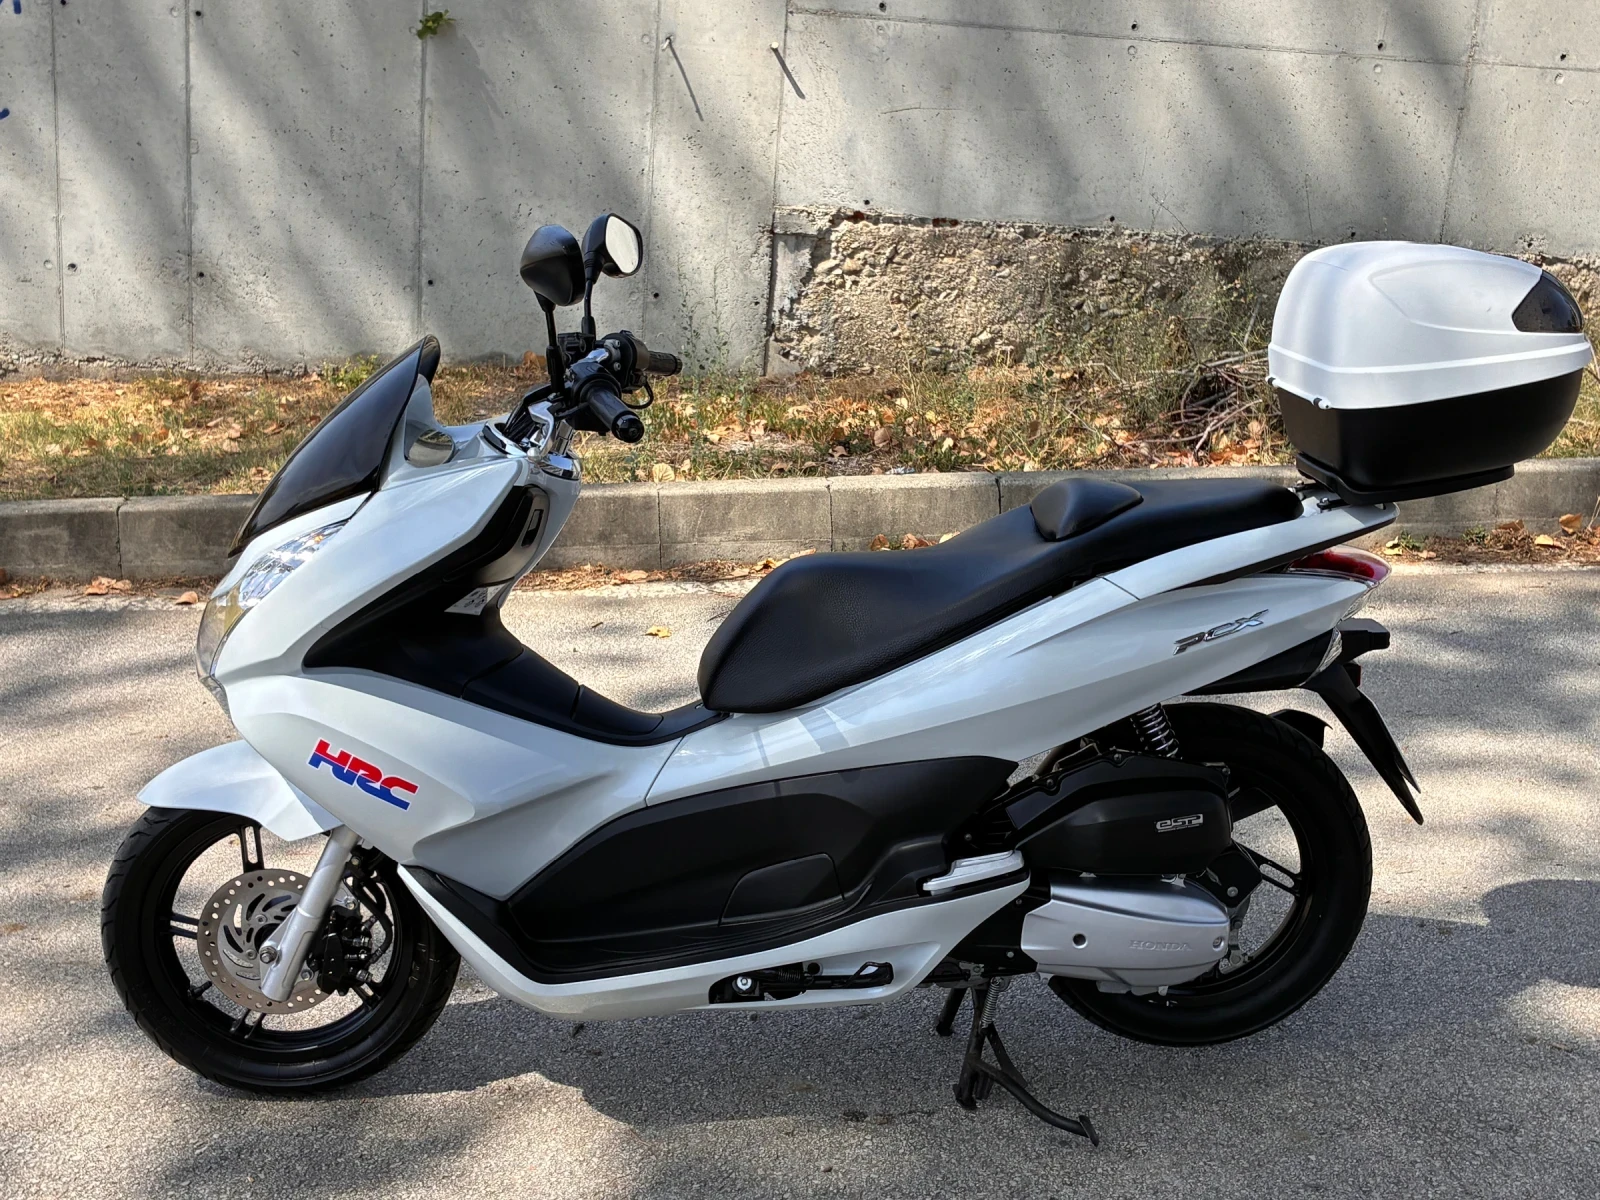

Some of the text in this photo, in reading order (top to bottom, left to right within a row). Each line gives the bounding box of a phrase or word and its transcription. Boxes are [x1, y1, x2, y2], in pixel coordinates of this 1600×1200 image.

[1173, 609, 1268, 655] PCX
[307, 738, 419, 811] HRC
[1129, 940, 1192, 951] HONDA
